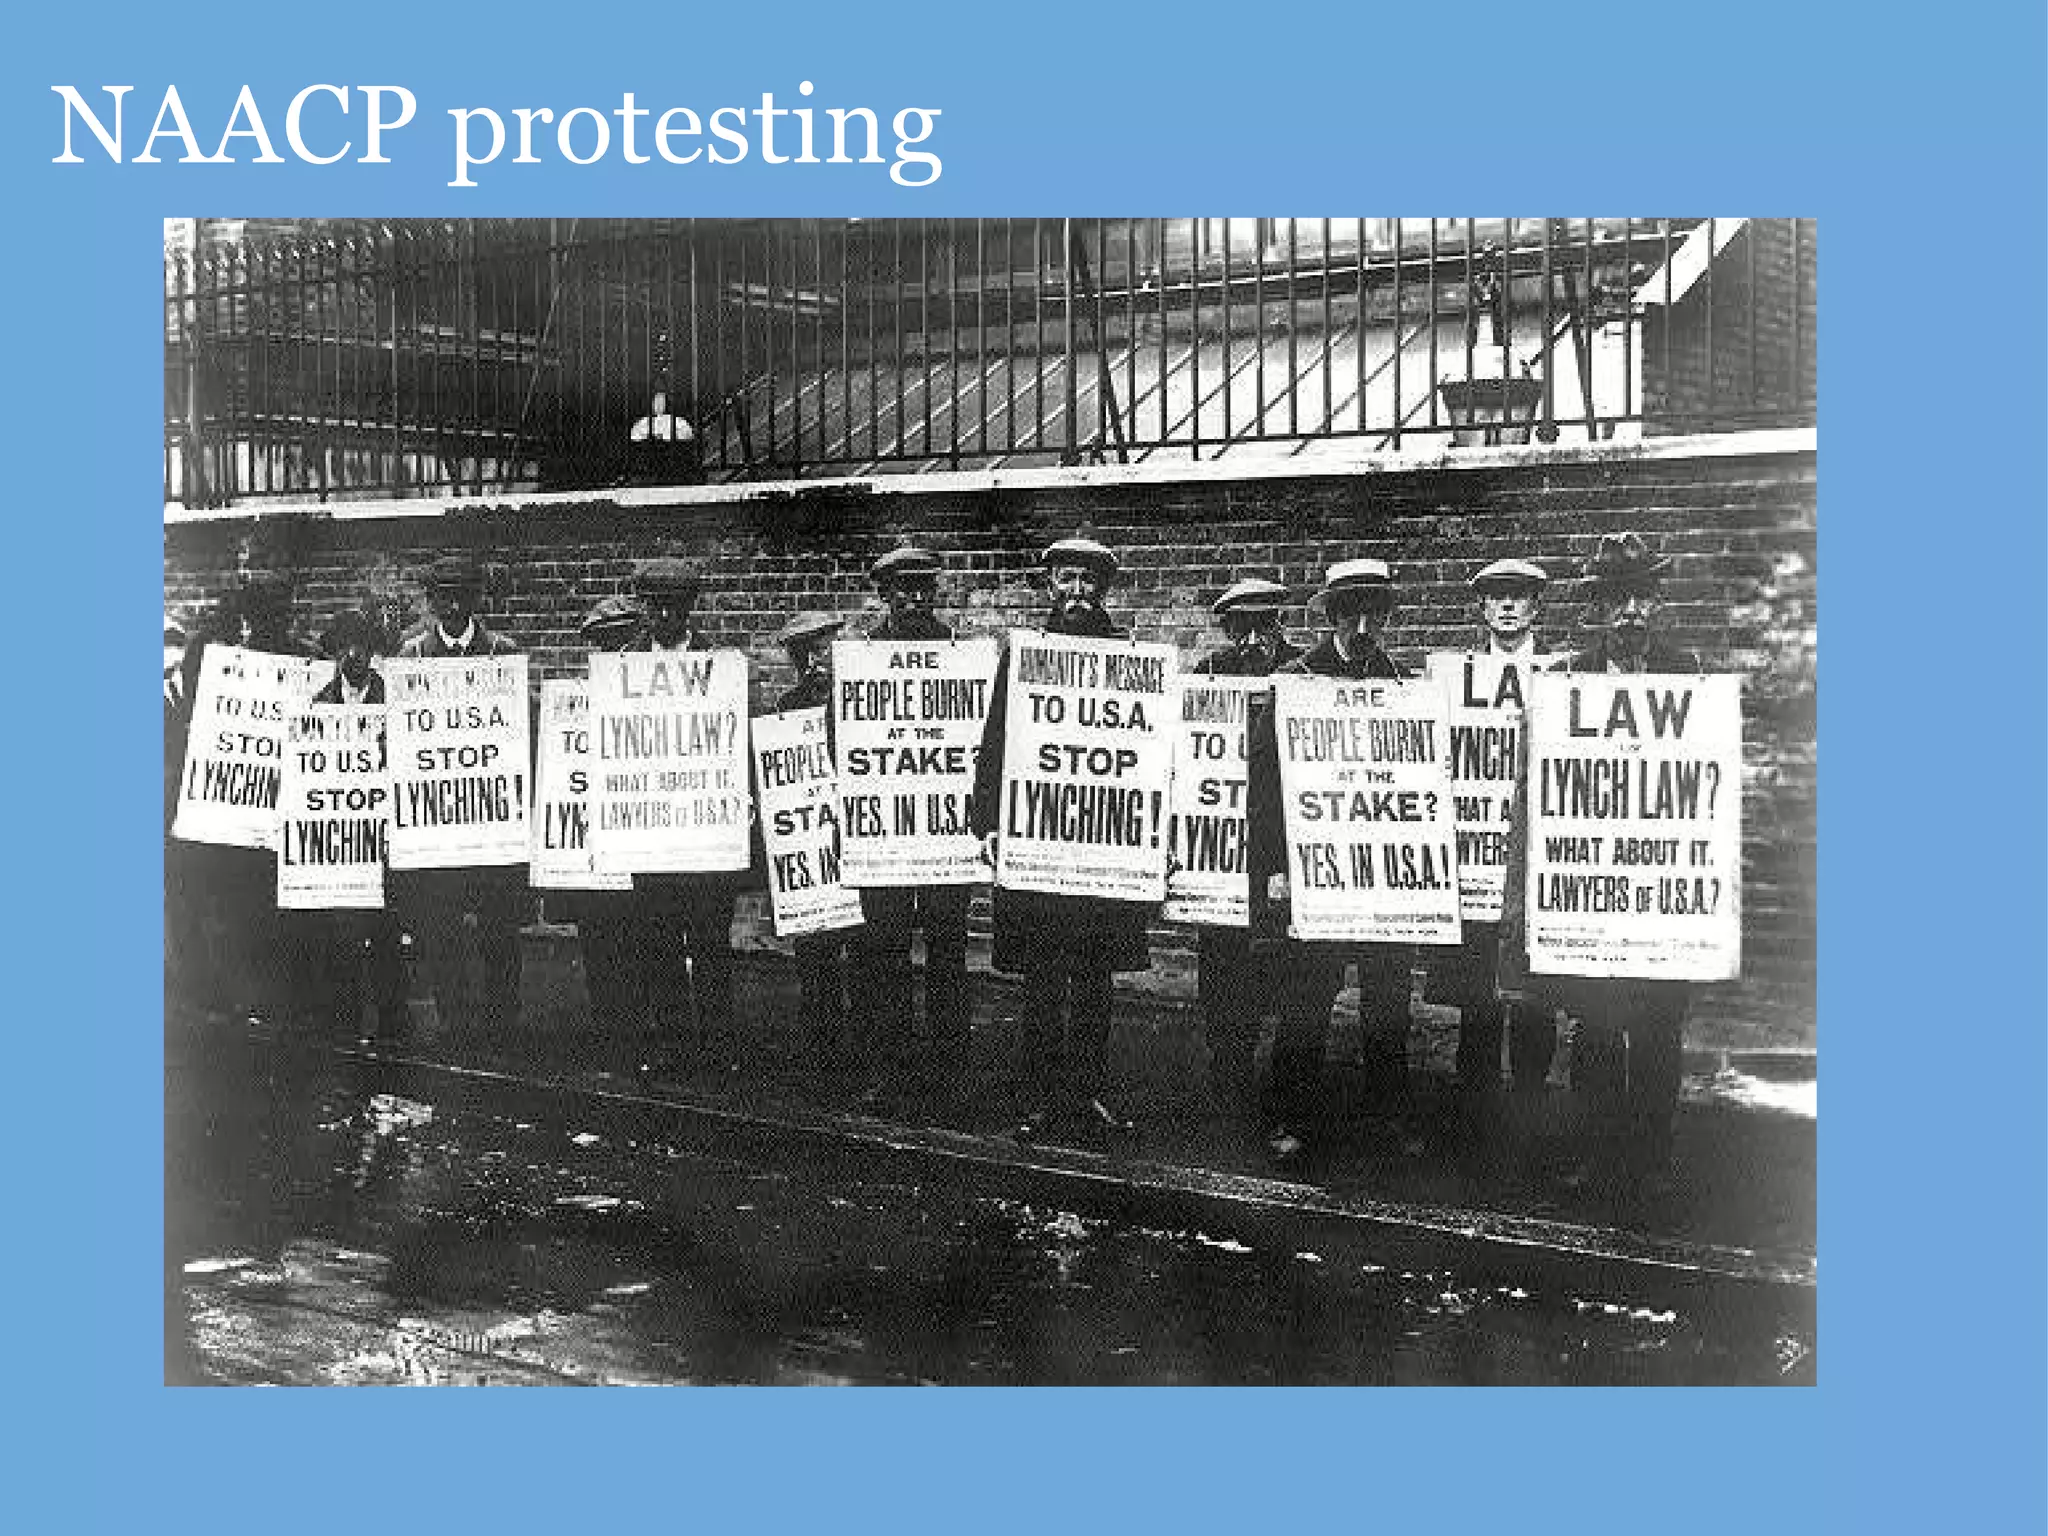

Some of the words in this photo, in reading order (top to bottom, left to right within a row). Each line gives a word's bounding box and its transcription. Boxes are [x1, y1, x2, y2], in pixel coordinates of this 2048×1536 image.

[889, 651, 940, 669] ARE
[621, 659, 714, 699] LAW
[1334, 687, 1385, 707] ARE
[1464, 663, 1524, 708] LA
[842, 679, 915, 721] PEOPLE
[922, 679, 987, 721] BURNT
[1029, 693, 1066, 723] TO
[1079, 698, 1153, 732] U.S.A.
[1570, 688, 1692, 739] LAW
[403, 709, 434, 732] TO
[601, 713, 668, 759] LYNCH
[675, 711, 738, 758] LAW?
[888, 728, 906, 740] AT
[914, 728, 945, 740] THE
[417, 744, 499, 770] STOP
[1190, 731, 1226, 759] TO
[1287, 718, 1364, 762] PEOPLE
[1369, 718, 1435, 763] BURNT
[297, 750, 326, 773] TO
[1039, 743, 1138, 778] STOP
[307, 789, 387, 810] STOP
[1300, 791, 1437, 822] STAKE?
[1541, 758, 1629, 819] LYNCH
[1639, 759, 1720, 819] LAW?
[893, 794, 915, 836] IN
[1350, 843, 1374, 890] IN
[1546, 837, 1603, 863] WHAT
[1612, 837, 1679, 865] ABOUT
[1689, 839, 1714, 866] IT.
[1538, 872, 1629, 912] LAWYERS
